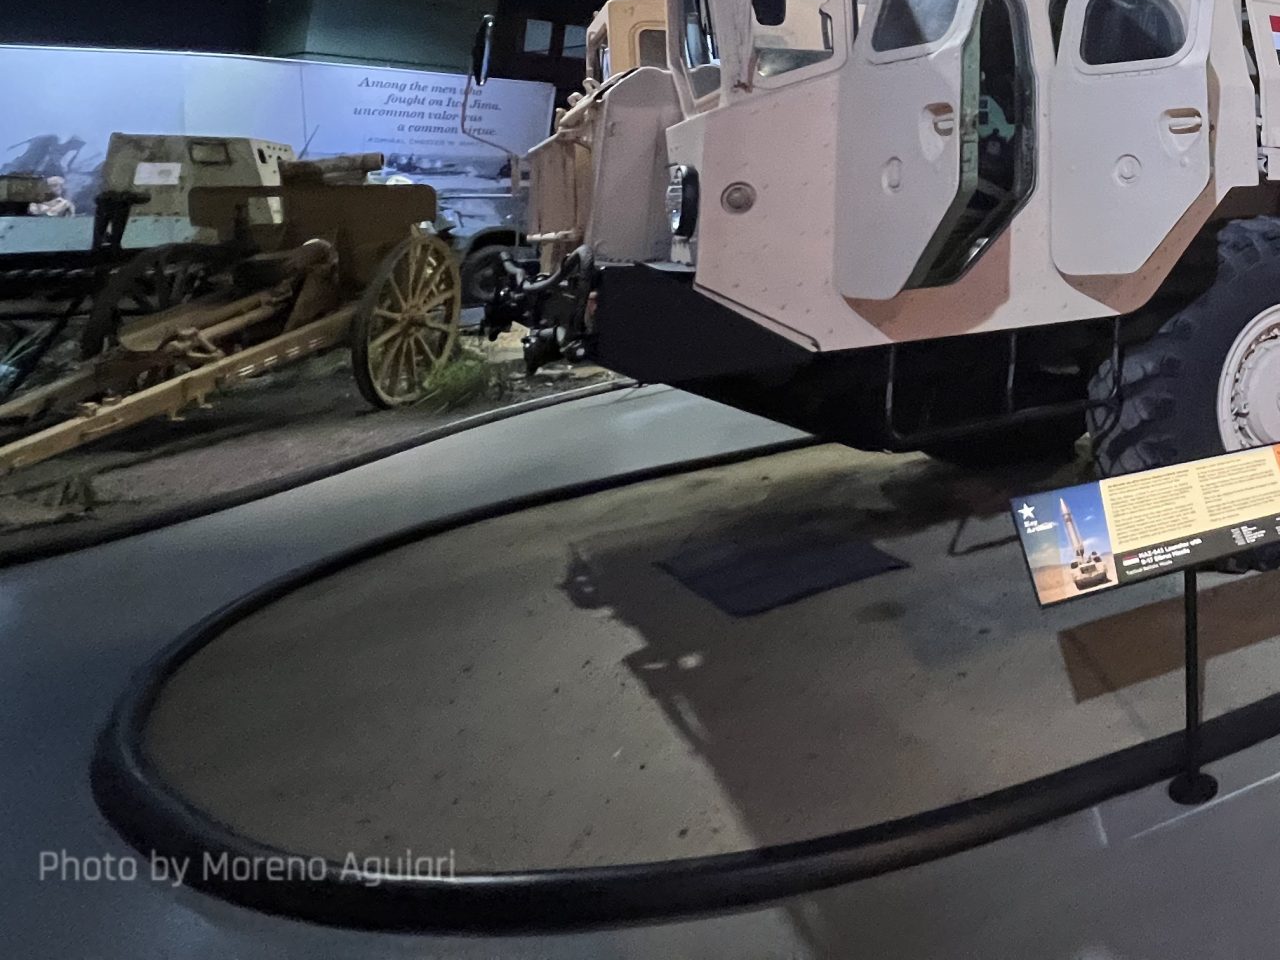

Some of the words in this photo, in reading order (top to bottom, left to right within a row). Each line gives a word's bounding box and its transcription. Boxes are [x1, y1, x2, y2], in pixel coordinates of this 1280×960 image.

[357, 76, 407, 90] Among
[409, 79, 428, 92] the
[430, 85, 456, 94] men
[384, 93, 426, 106] fought
[428, 99, 444, 107] on
[353, 107, 426, 120] uncommon
[428, 110, 459, 121] valor
[397, 124, 405, 132] a
[408, 124, 458, 134] common
